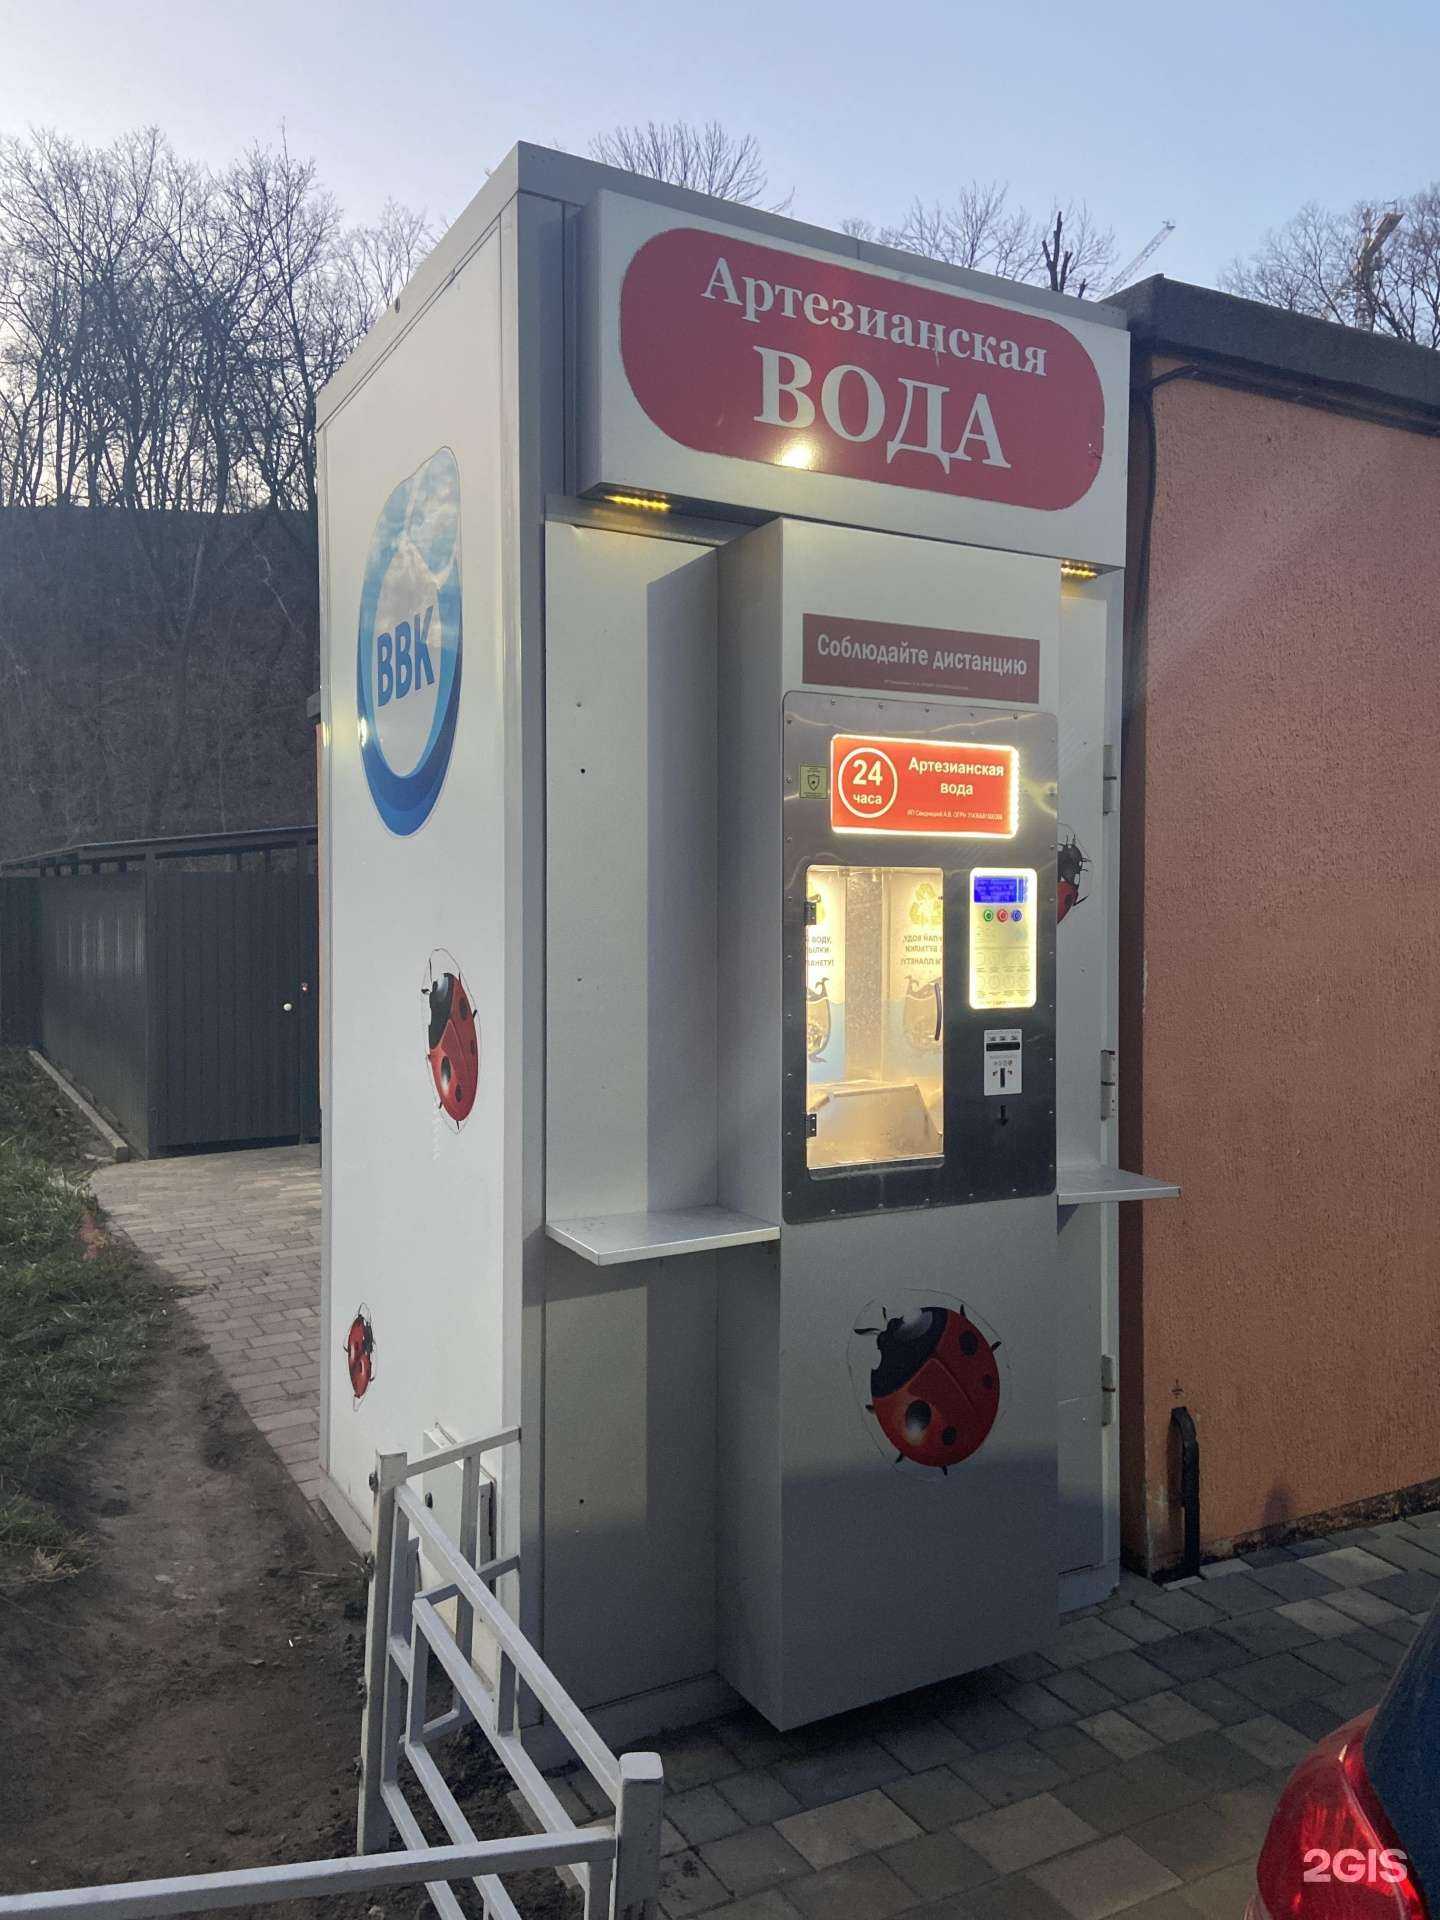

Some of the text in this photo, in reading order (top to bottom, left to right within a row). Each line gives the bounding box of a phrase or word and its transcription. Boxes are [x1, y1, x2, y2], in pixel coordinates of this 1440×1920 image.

[701, 257, 1047, 377] Артезианская
[753, 345, 1012, 474] ВОДА
[377, 605, 435, 707] ВВК
[817, 634, 1027, 676] Соблюдайте дистанцию
[852, 759, 883, 786] 24
[908, 757, 1004, 776] Артезианская
[853, 793, 882, 805] часа
[940, 782, 973, 797] вода
